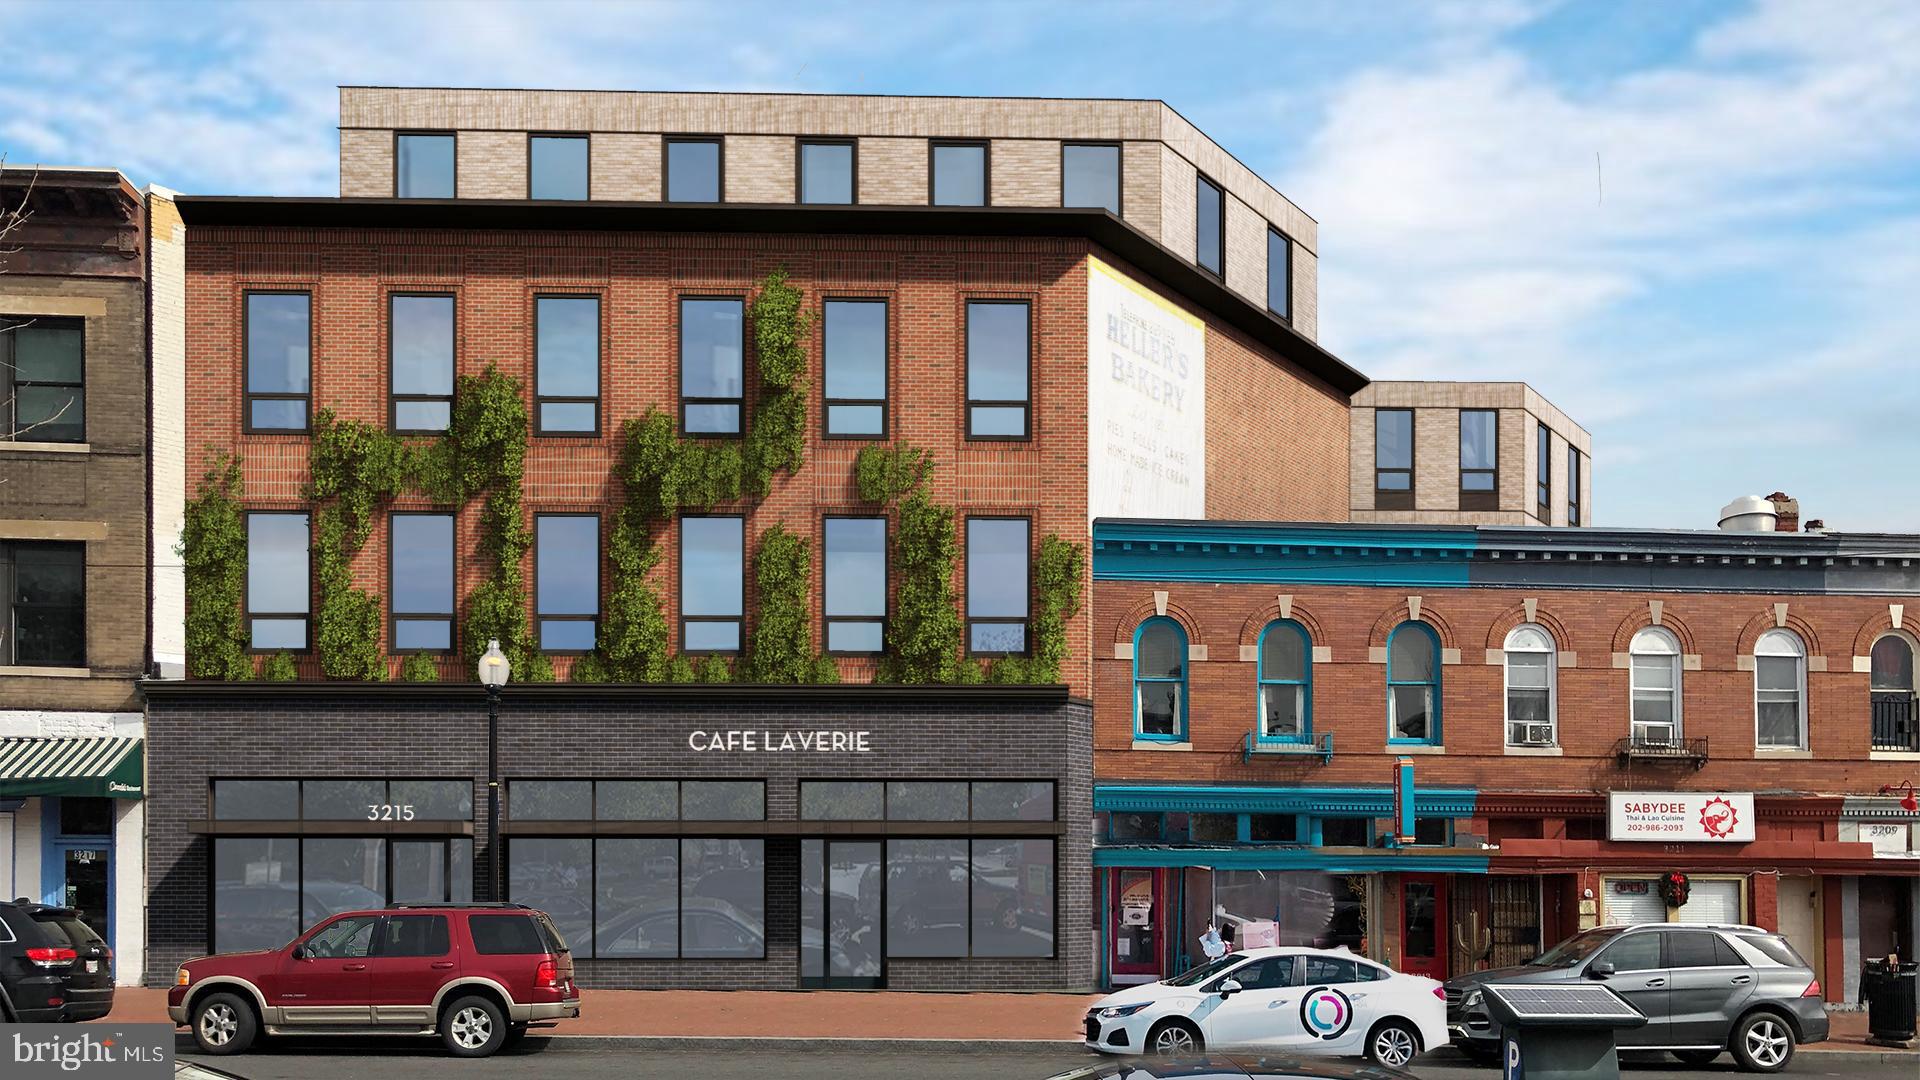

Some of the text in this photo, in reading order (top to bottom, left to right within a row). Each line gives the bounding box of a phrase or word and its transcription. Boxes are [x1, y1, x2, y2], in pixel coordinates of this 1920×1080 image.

[1107, 312, 1189, 380] HELLER'S
[1111, 352, 1186, 413] BAKERY
[688, 731, 870, 751] CAFE LAVERIE
[367, 804, 415, 821] 3215
[1624, 802, 1686, 814] SABYDEE
[1661, 814, 1685, 822] Cuisine
[1627, 824, 1684, 832] 202-986-2093
[1871, 825, 1898, 835] 3209
[75, 850, 95, 860] 3217
[1615, 882, 1647, 894] OPEN
[1508, 1040, 1520, 1080] P
